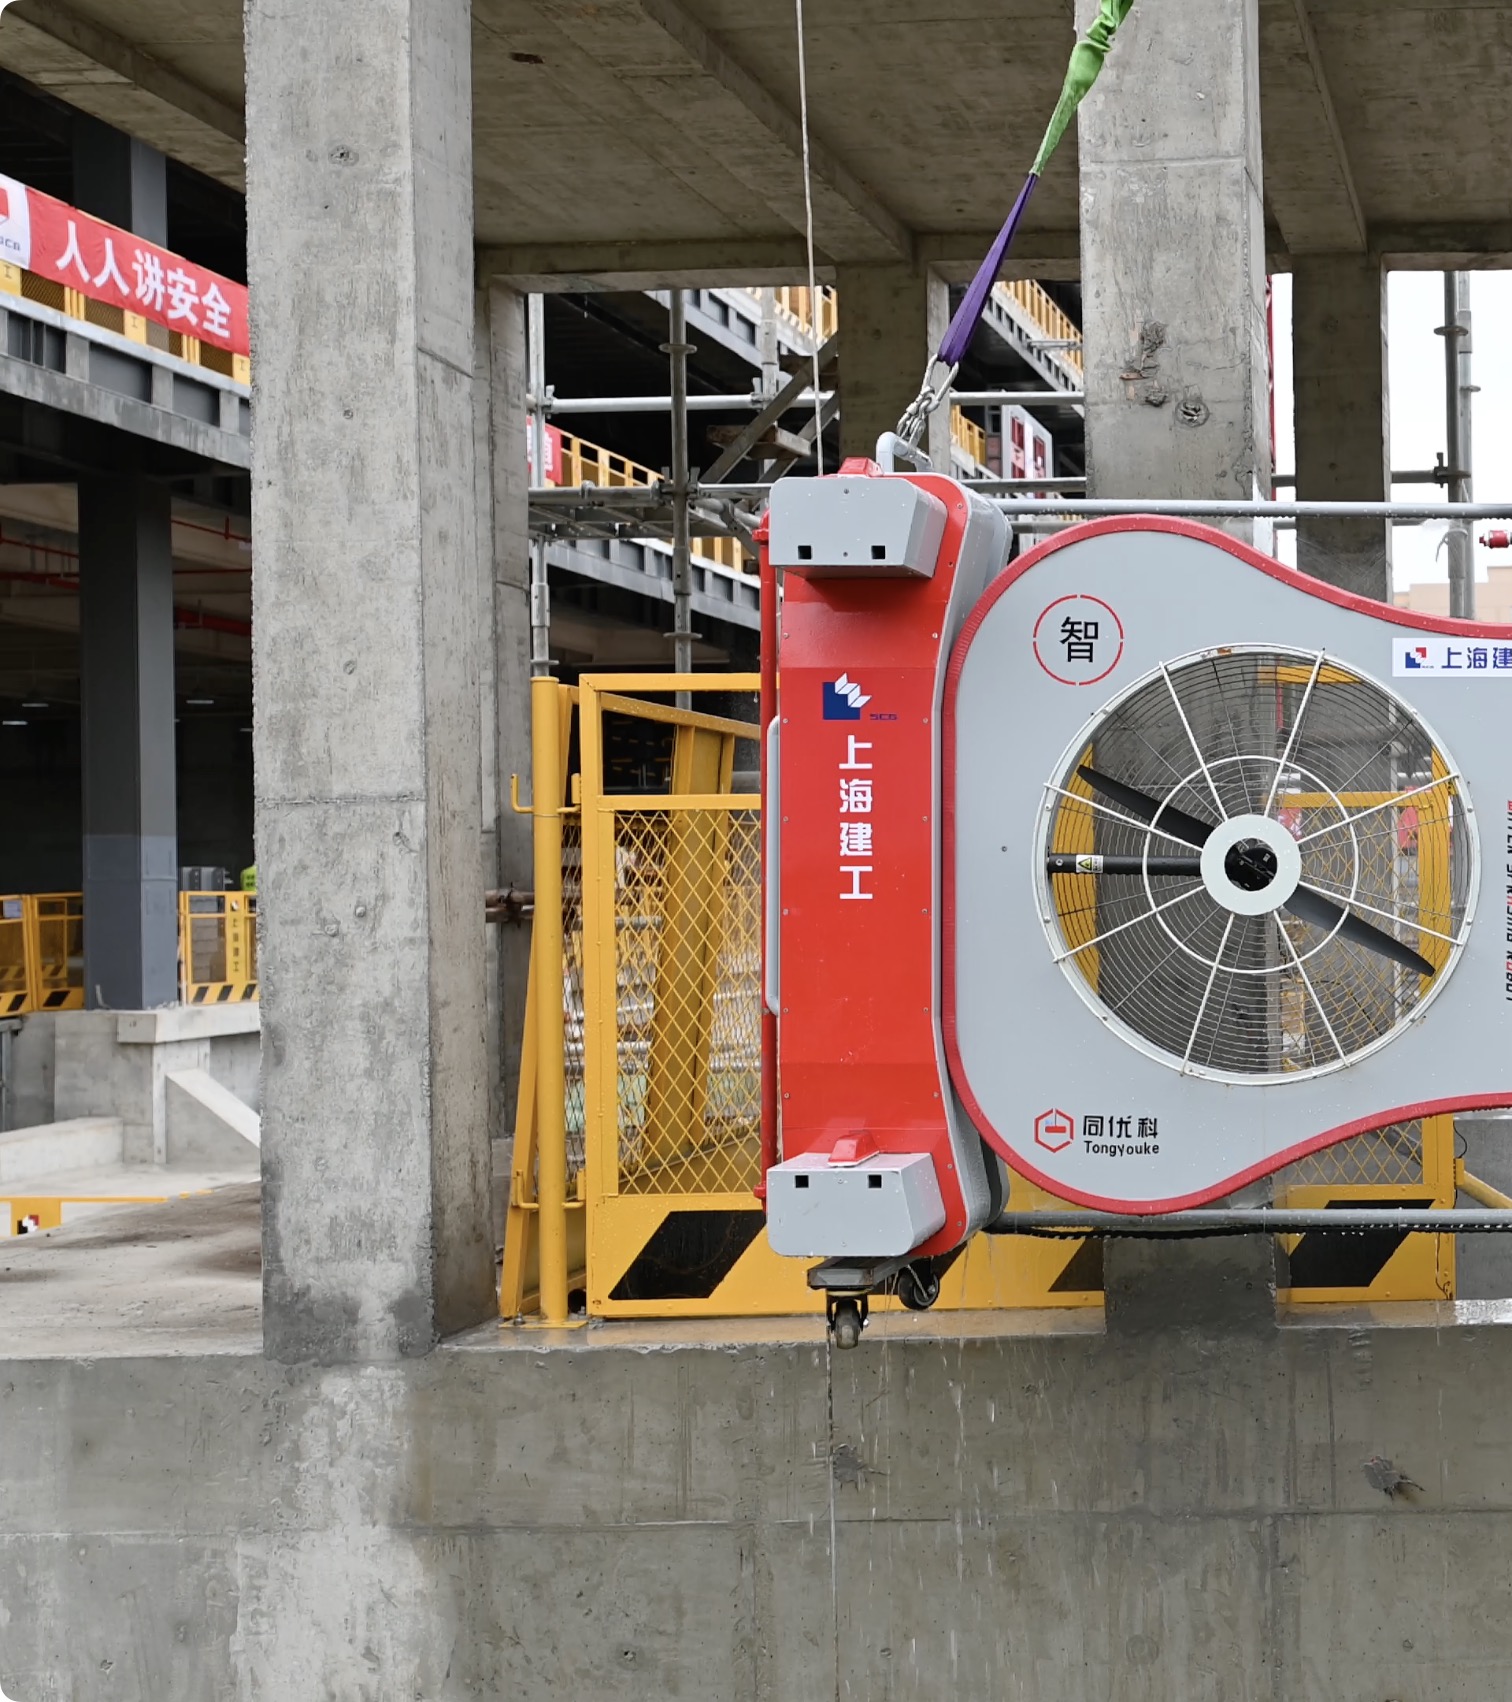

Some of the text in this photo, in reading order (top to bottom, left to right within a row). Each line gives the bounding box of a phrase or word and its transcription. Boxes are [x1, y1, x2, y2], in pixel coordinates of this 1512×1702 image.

[56, 219, 232, 339] 人人讲安全
[1060, 616, 1099, 663] 智
[838, 734, 873, 900] 上海建工
[1083, 1115, 1158, 1138] 同优科
[1084, 1141, 1160, 1157] Tongyouke
